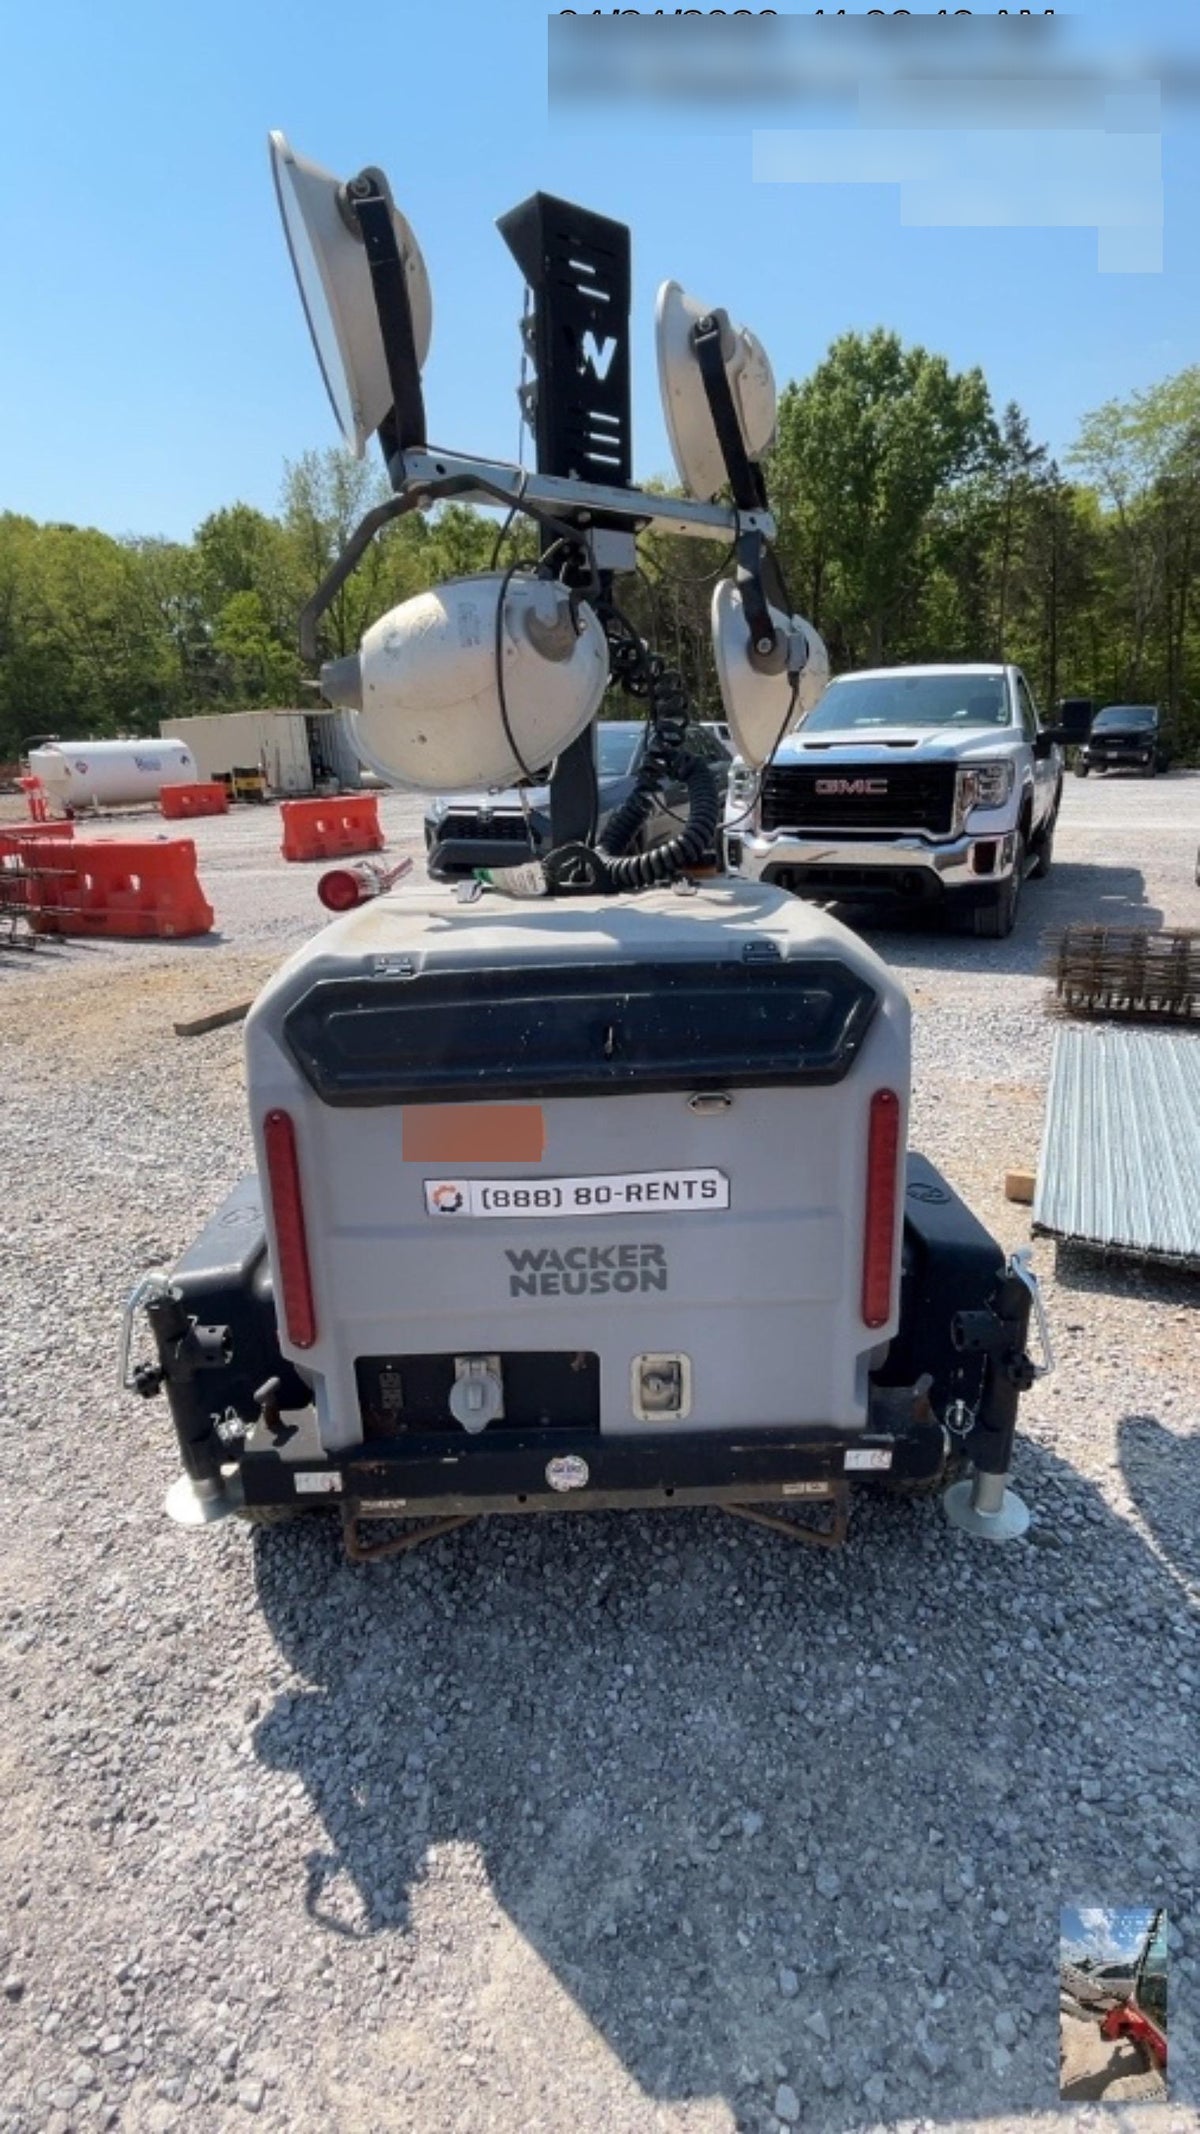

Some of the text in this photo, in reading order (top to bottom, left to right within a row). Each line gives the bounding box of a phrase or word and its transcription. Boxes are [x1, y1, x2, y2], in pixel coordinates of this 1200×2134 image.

[815, 779, 888, 795] GMC
[481, 1179, 718, 1209] (888) 80-RENTS
[504, 1243, 668, 1271] WACKER
[509, 1268, 668, 1298] NEUSON
